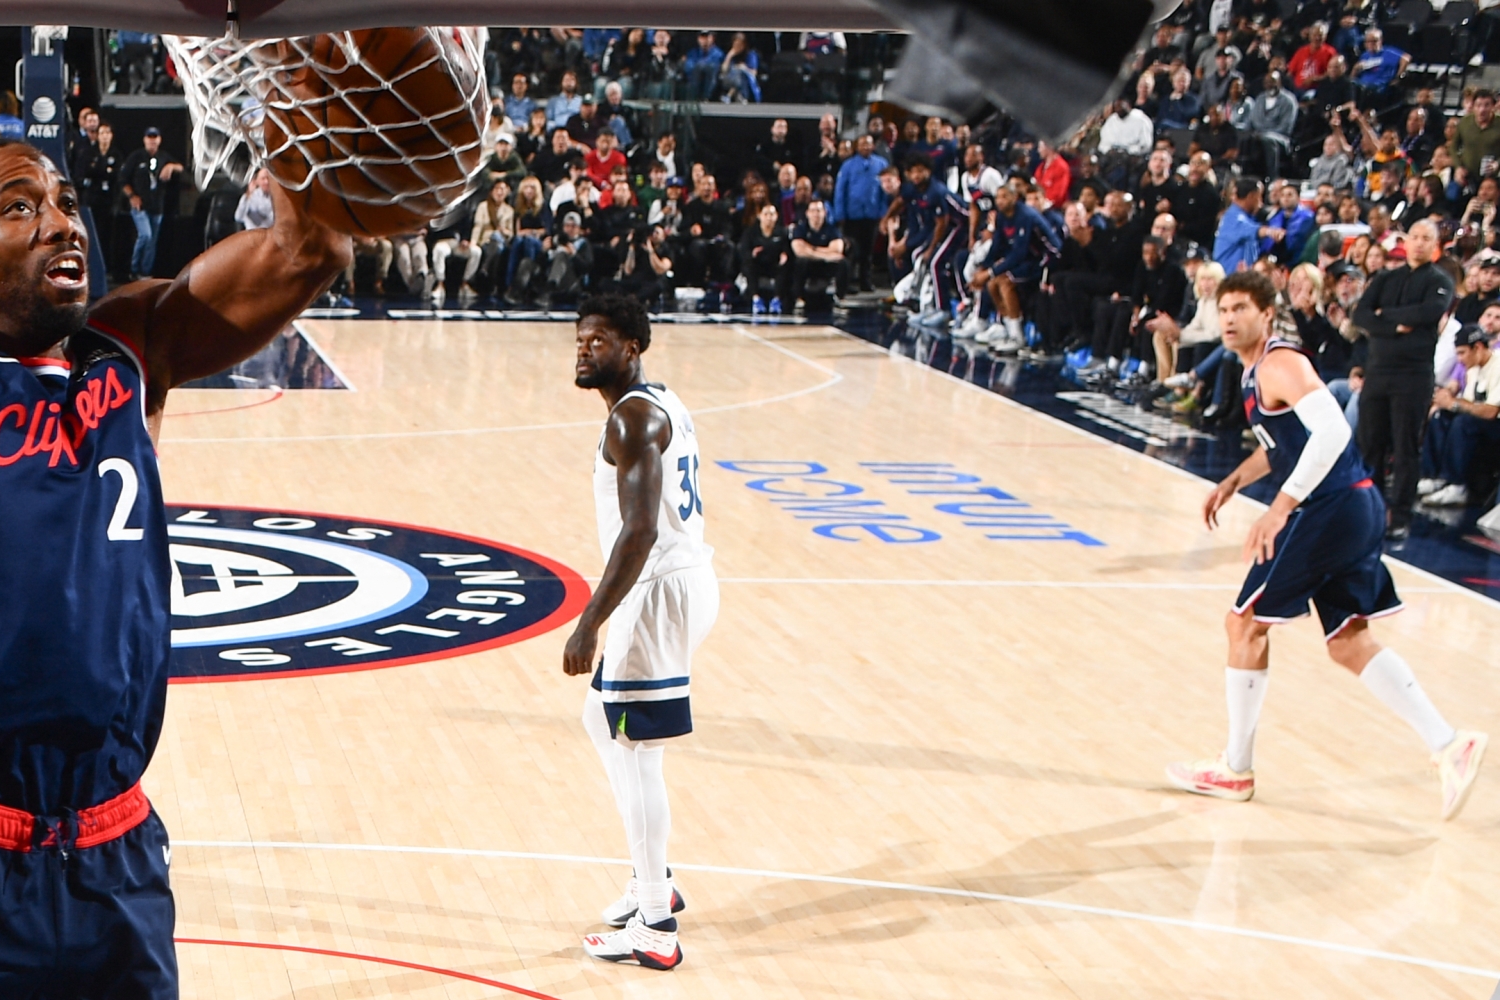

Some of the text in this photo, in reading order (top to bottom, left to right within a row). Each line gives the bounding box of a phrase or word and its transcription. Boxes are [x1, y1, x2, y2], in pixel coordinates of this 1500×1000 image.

[27, 124, 60, 138] AT&T
[98, 457, 144, 541] 2
[677, 453, 703, 522] 3
[175, 510, 526, 667] LOS ANGELES
